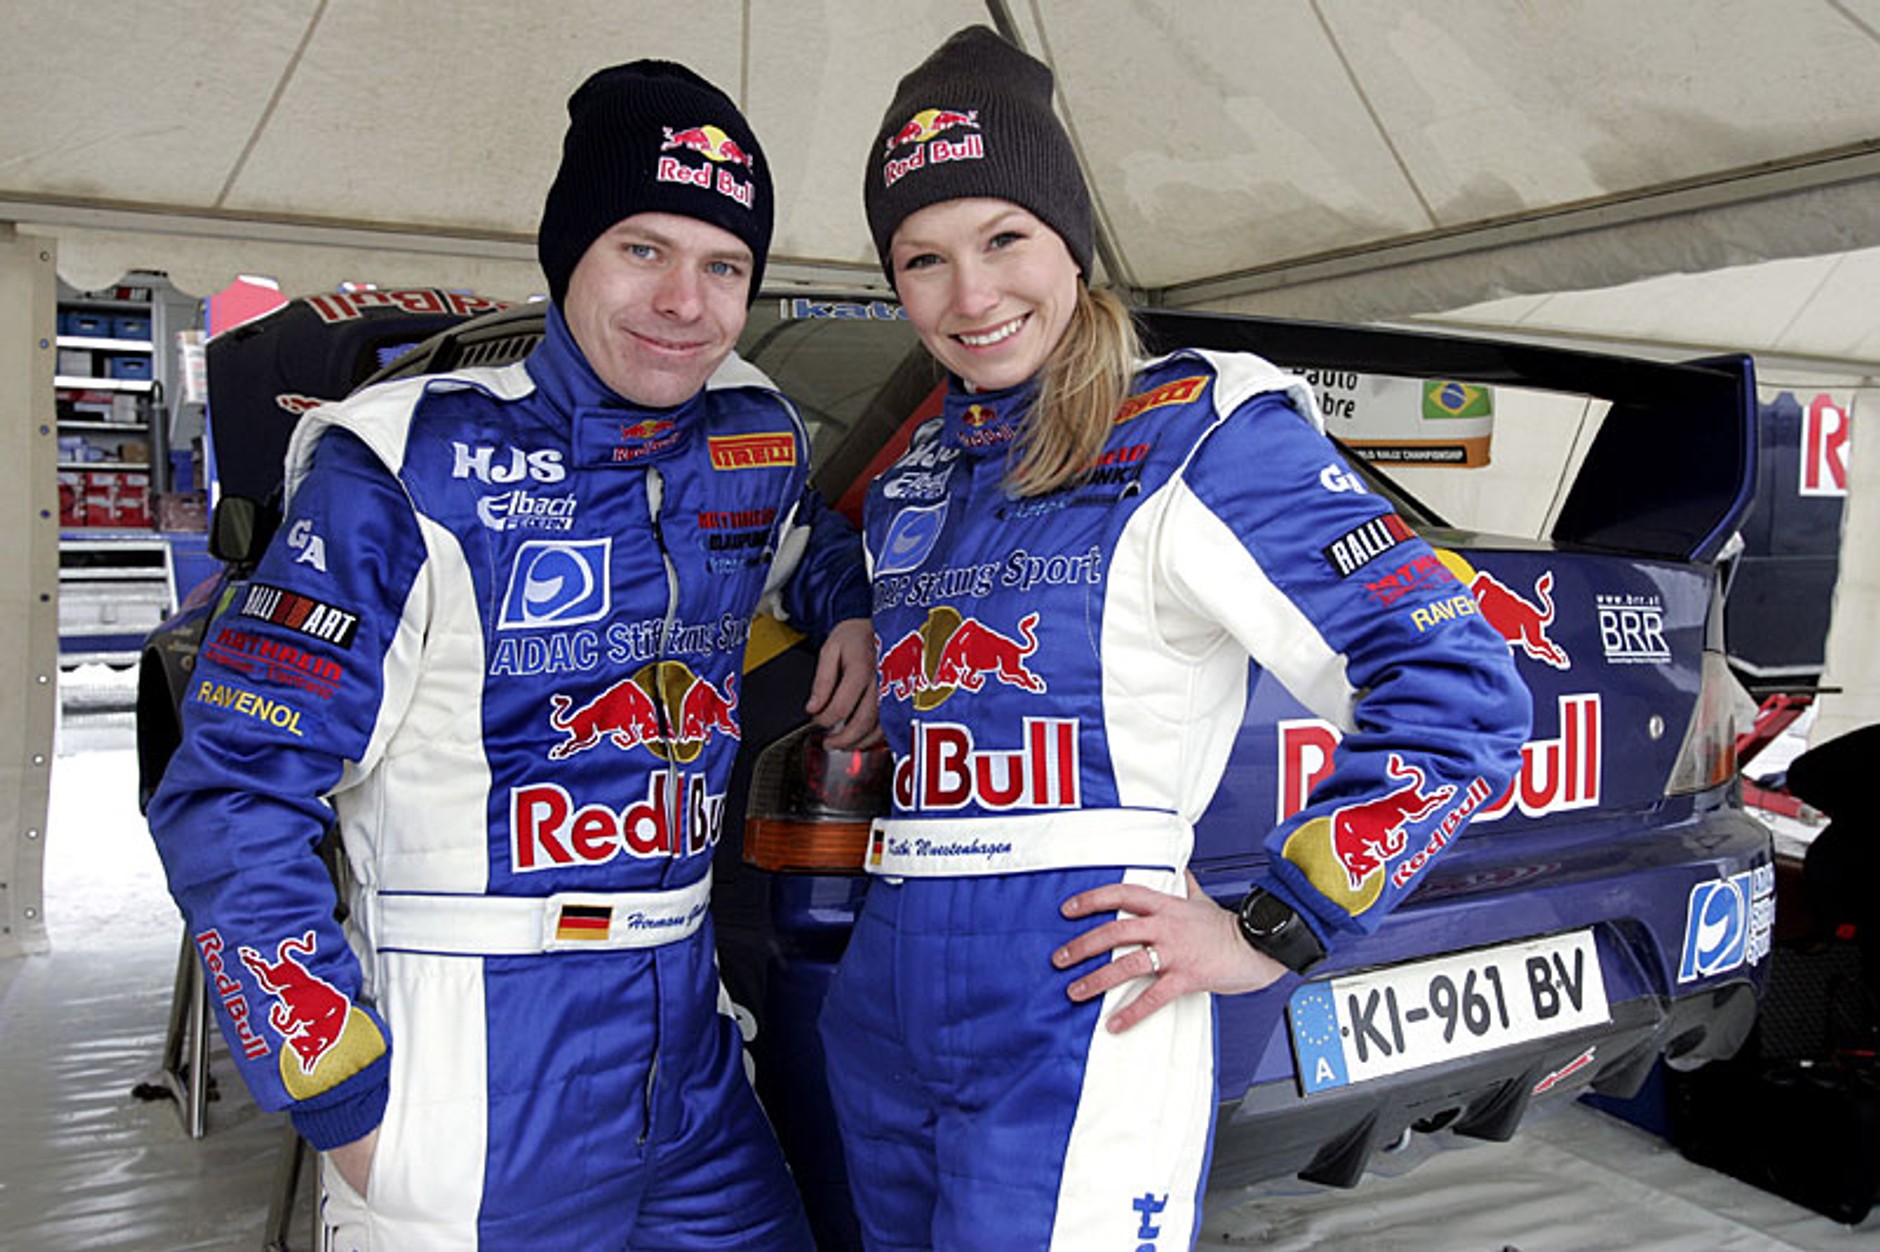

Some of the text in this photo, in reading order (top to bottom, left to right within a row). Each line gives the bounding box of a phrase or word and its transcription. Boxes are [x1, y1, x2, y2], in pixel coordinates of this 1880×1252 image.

[657, 156, 712, 188] Red
[886, 135, 983, 187] Red Bull
[1315, 392, 1355, 419] bre
[453, 442, 566, 484] HJS
[1001, 545, 1101, 592] Sport
[301, 603, 357, 644] ART
[1600, 610, 1670, 652] BRR
[489, 630, 599, 676] ADAC
[197, 680, 304, 737] RAVENOL
[919, 716, 1082, 812] Bull
[510, 770, 686, 874] Red
[1391, 776, 1493, 888] Red Bull
[196, 928, 272, 1061] Red Bull
[1348, 946, 1584, 1064] KI-961 BV
[1315, 1056, 1336, 1085] A
